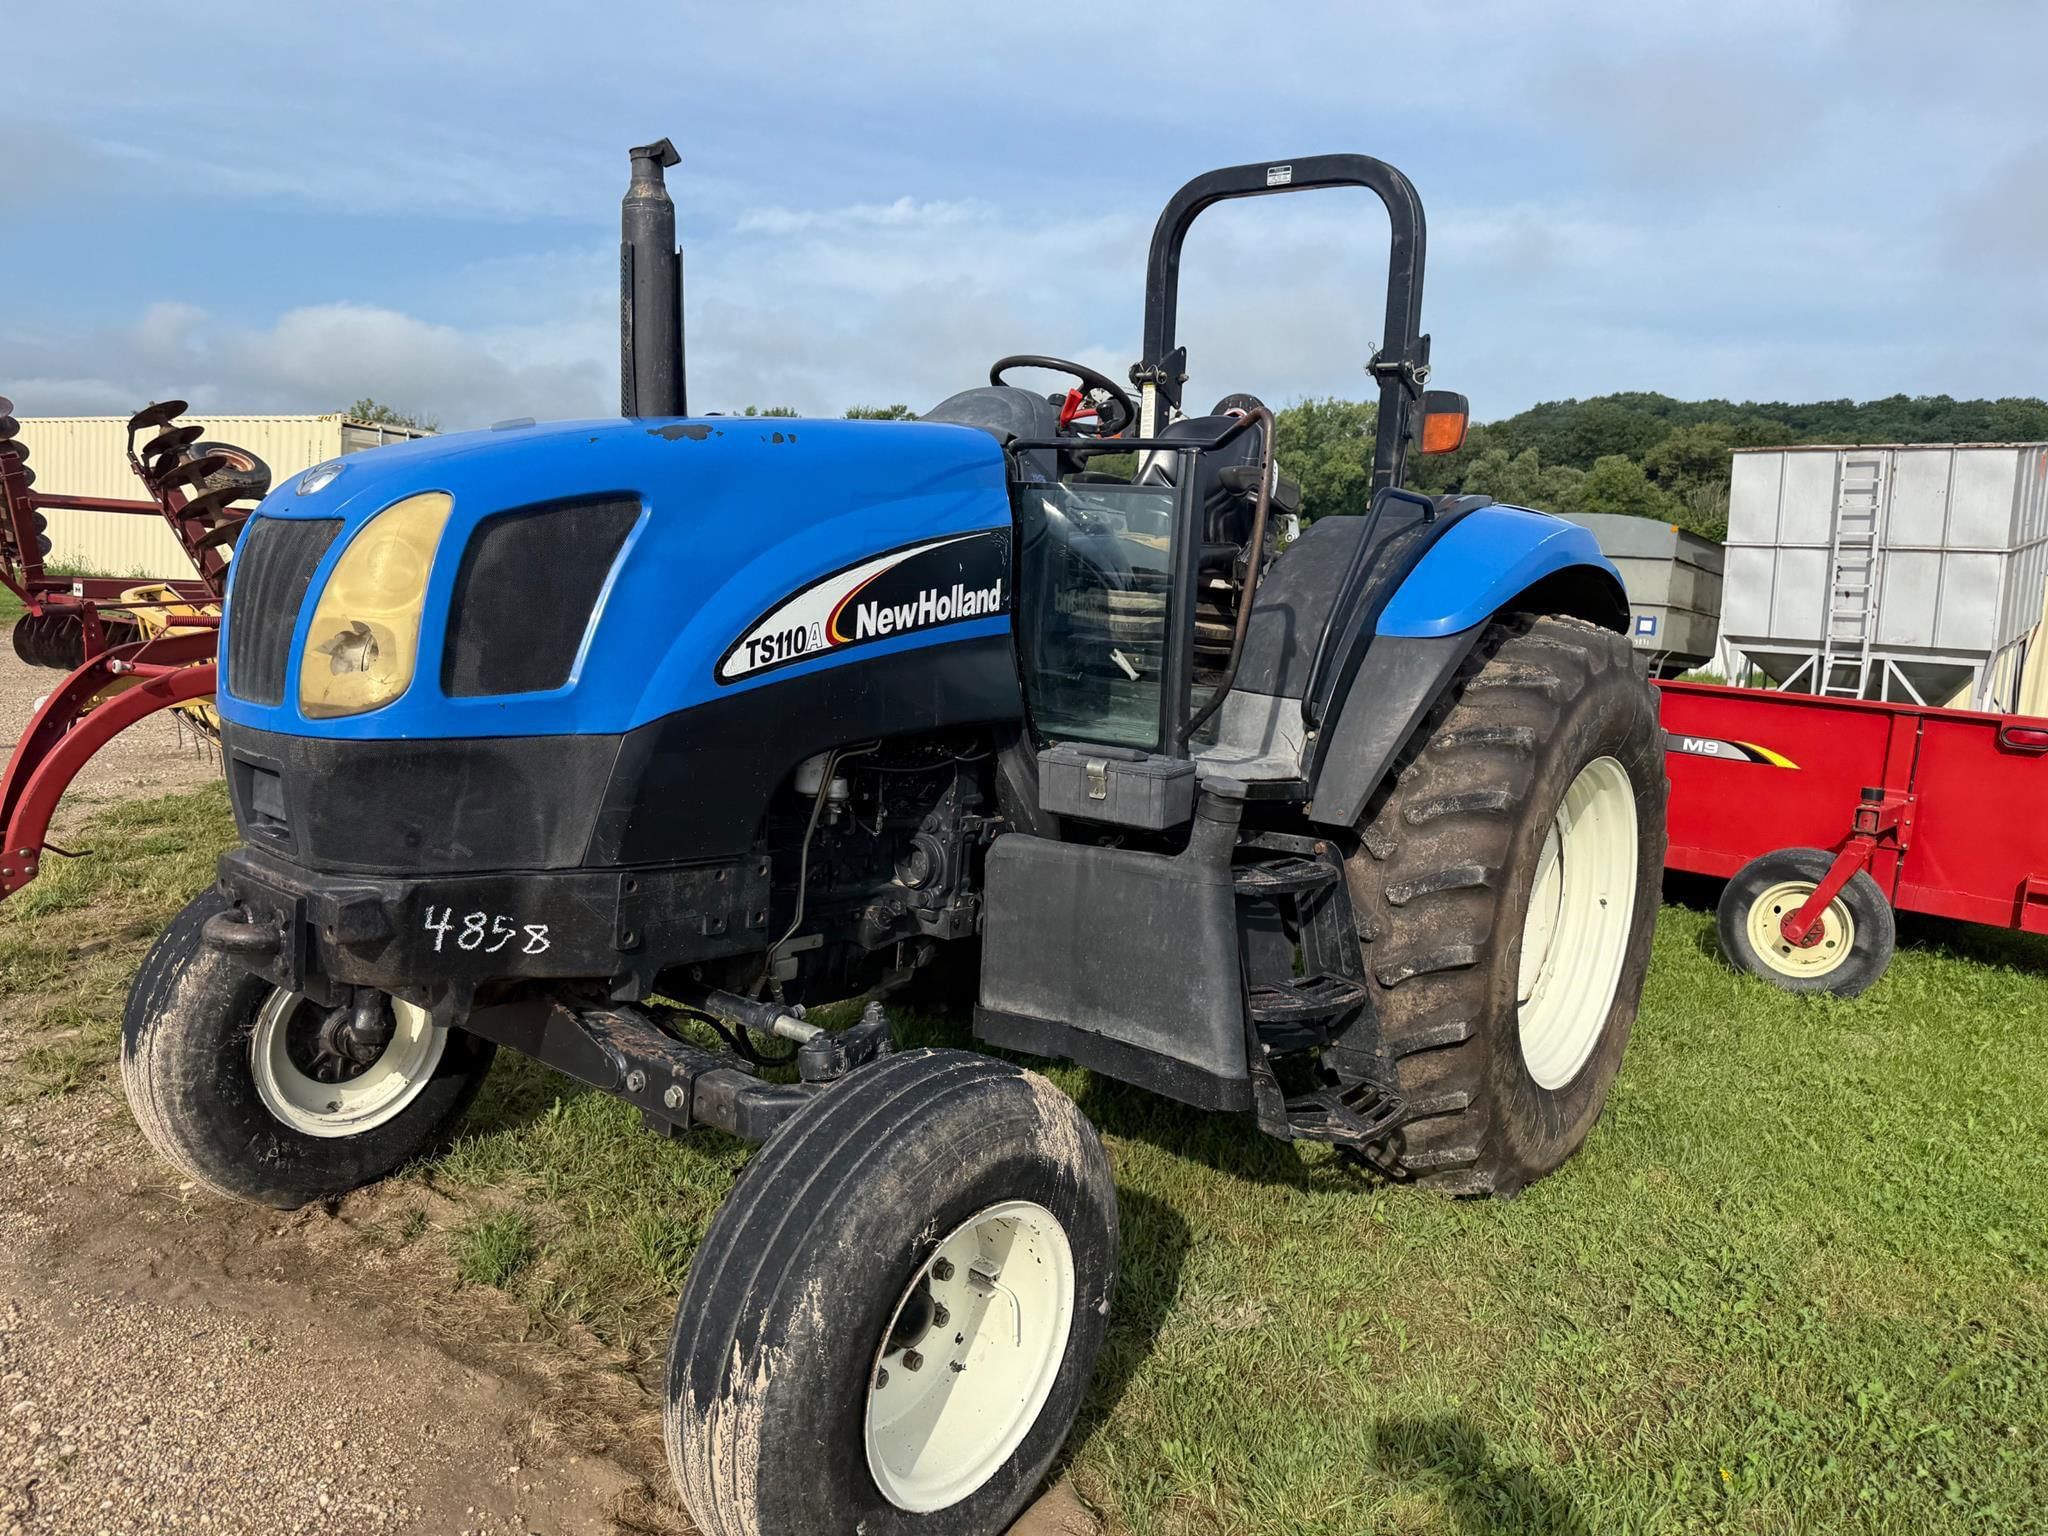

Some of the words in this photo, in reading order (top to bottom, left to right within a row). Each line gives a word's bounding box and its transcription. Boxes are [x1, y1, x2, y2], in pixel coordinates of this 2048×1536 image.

[745, 621, 823, 668] TS110A
[1682, 738, 1719, 754] M9
[423, 904, 551, 955] 4858
